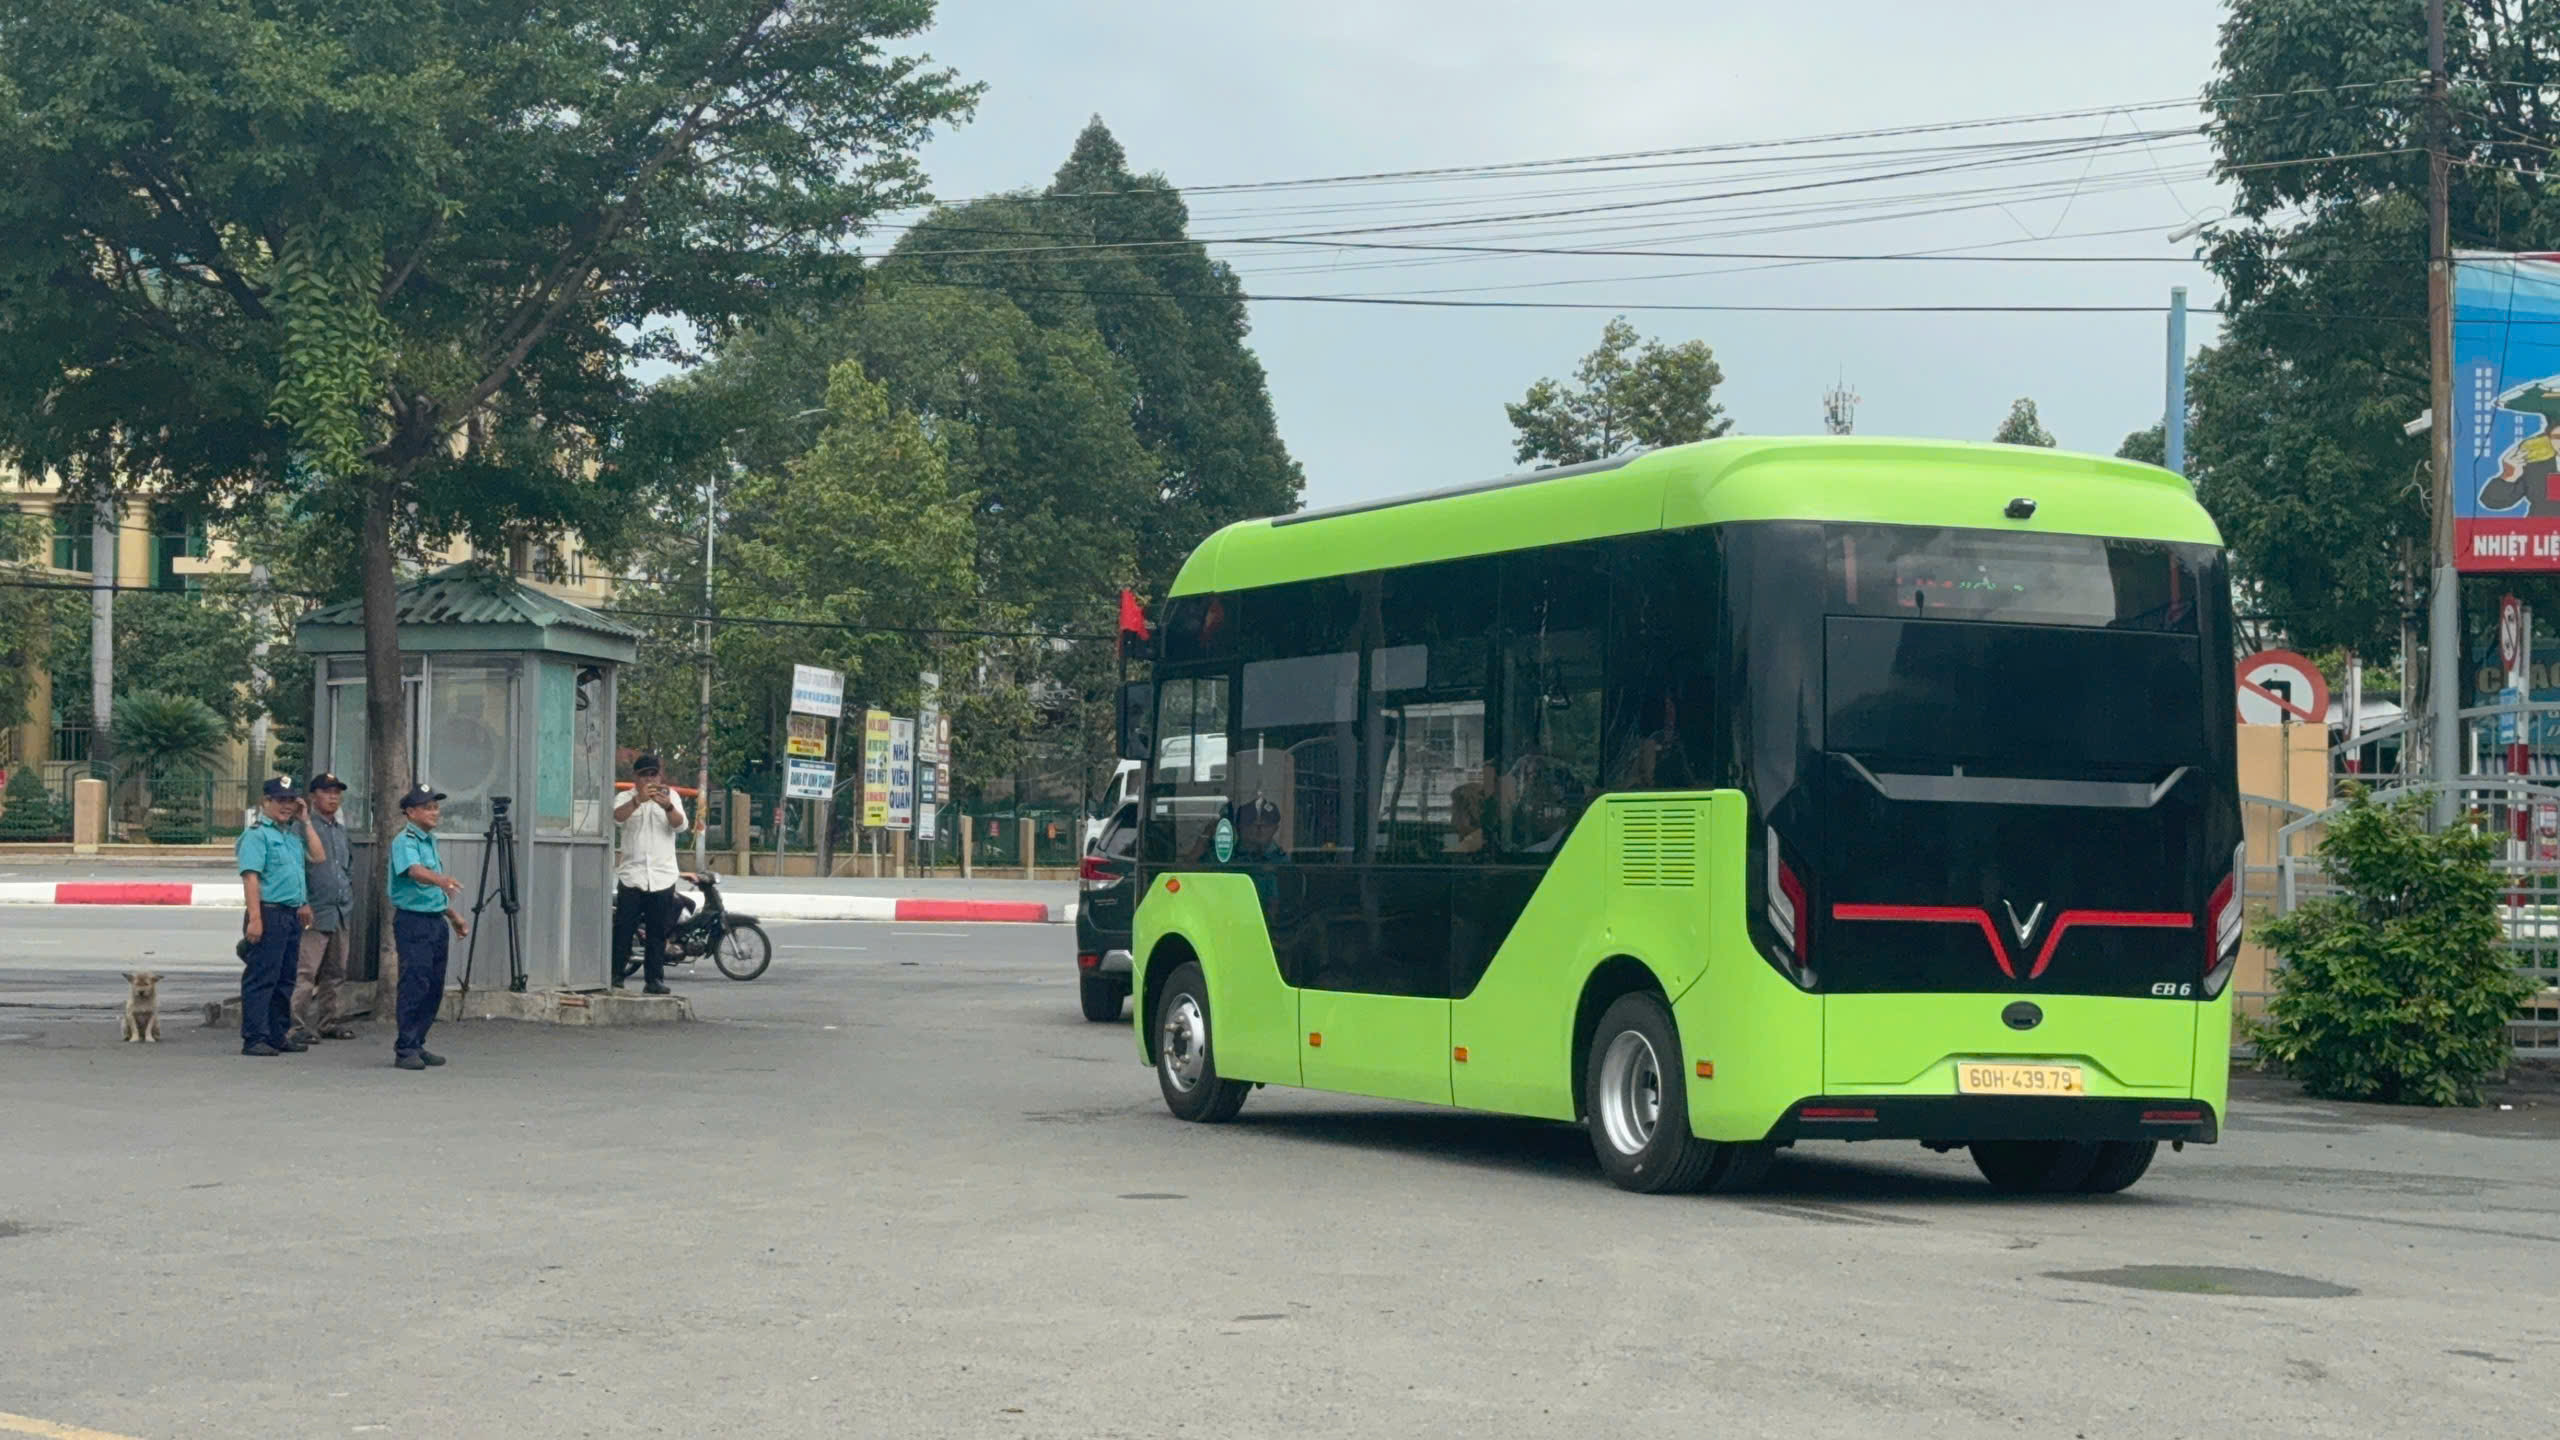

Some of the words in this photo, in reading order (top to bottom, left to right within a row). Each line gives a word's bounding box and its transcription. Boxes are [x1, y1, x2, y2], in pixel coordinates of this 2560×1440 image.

[2473, 530, 2528, 562] NHIỆT
[2151, 982, 2177, 996] EB
[2180, 983, 2191, 996] 6
